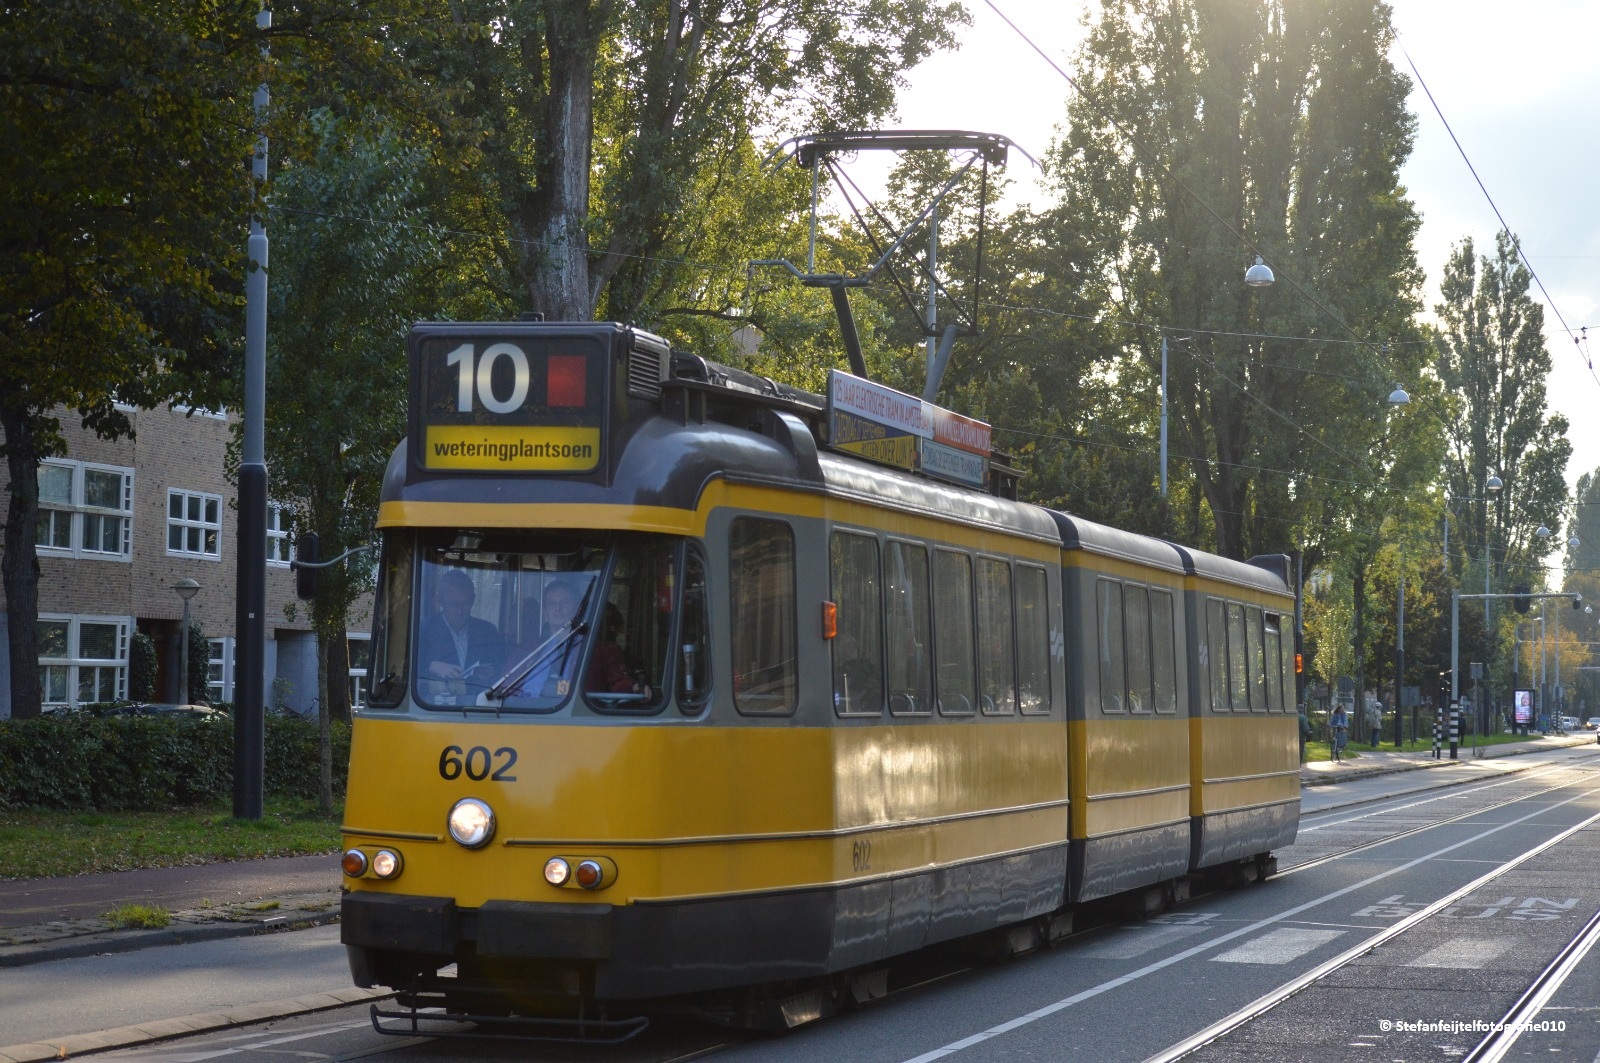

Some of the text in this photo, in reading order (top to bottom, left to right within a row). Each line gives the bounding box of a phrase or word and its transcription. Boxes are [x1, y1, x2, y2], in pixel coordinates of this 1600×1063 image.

[446, 342, 530, 414] 10
[434, 438, 593, 461] weteringplantsoen
[438, 745, 518, 783] 602
[851, 839, 872, 873] 602
[1350, 905, 1564, 921] BUS
